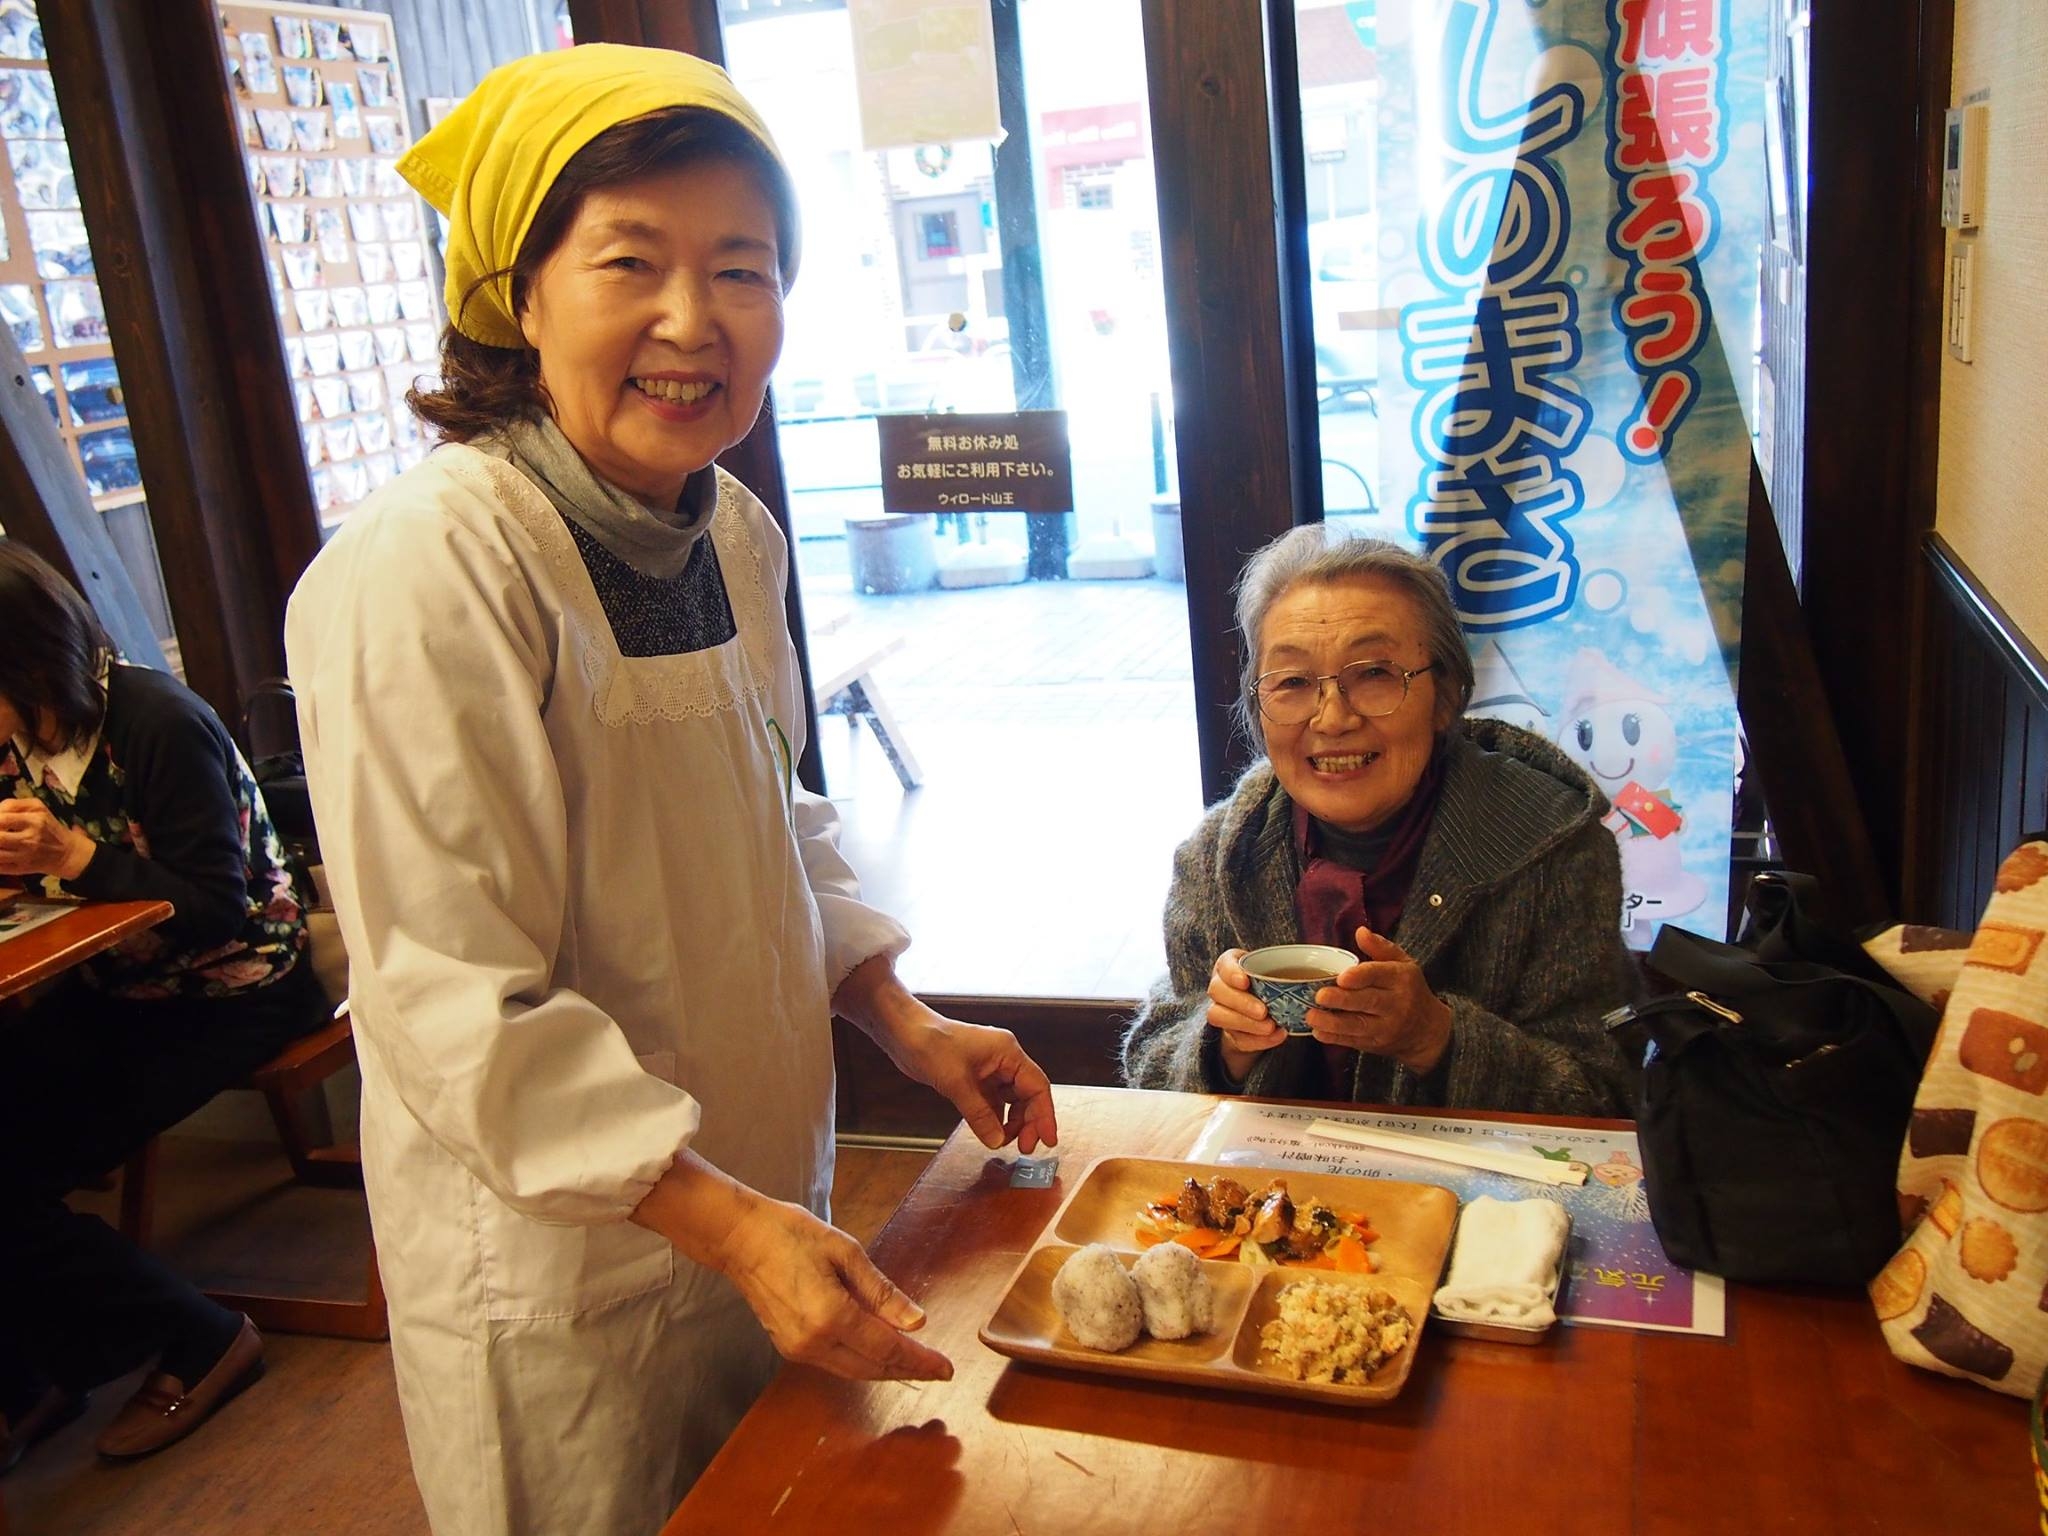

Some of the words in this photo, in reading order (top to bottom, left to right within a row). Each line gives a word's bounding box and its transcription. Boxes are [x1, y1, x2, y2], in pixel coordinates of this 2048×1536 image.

[927, 434, 1020, 452] 無料お休み処
[896, 461, 1056, 480] お気軽にご利用下さい。
[937, 491, 1015, 506] ウィロード山王
